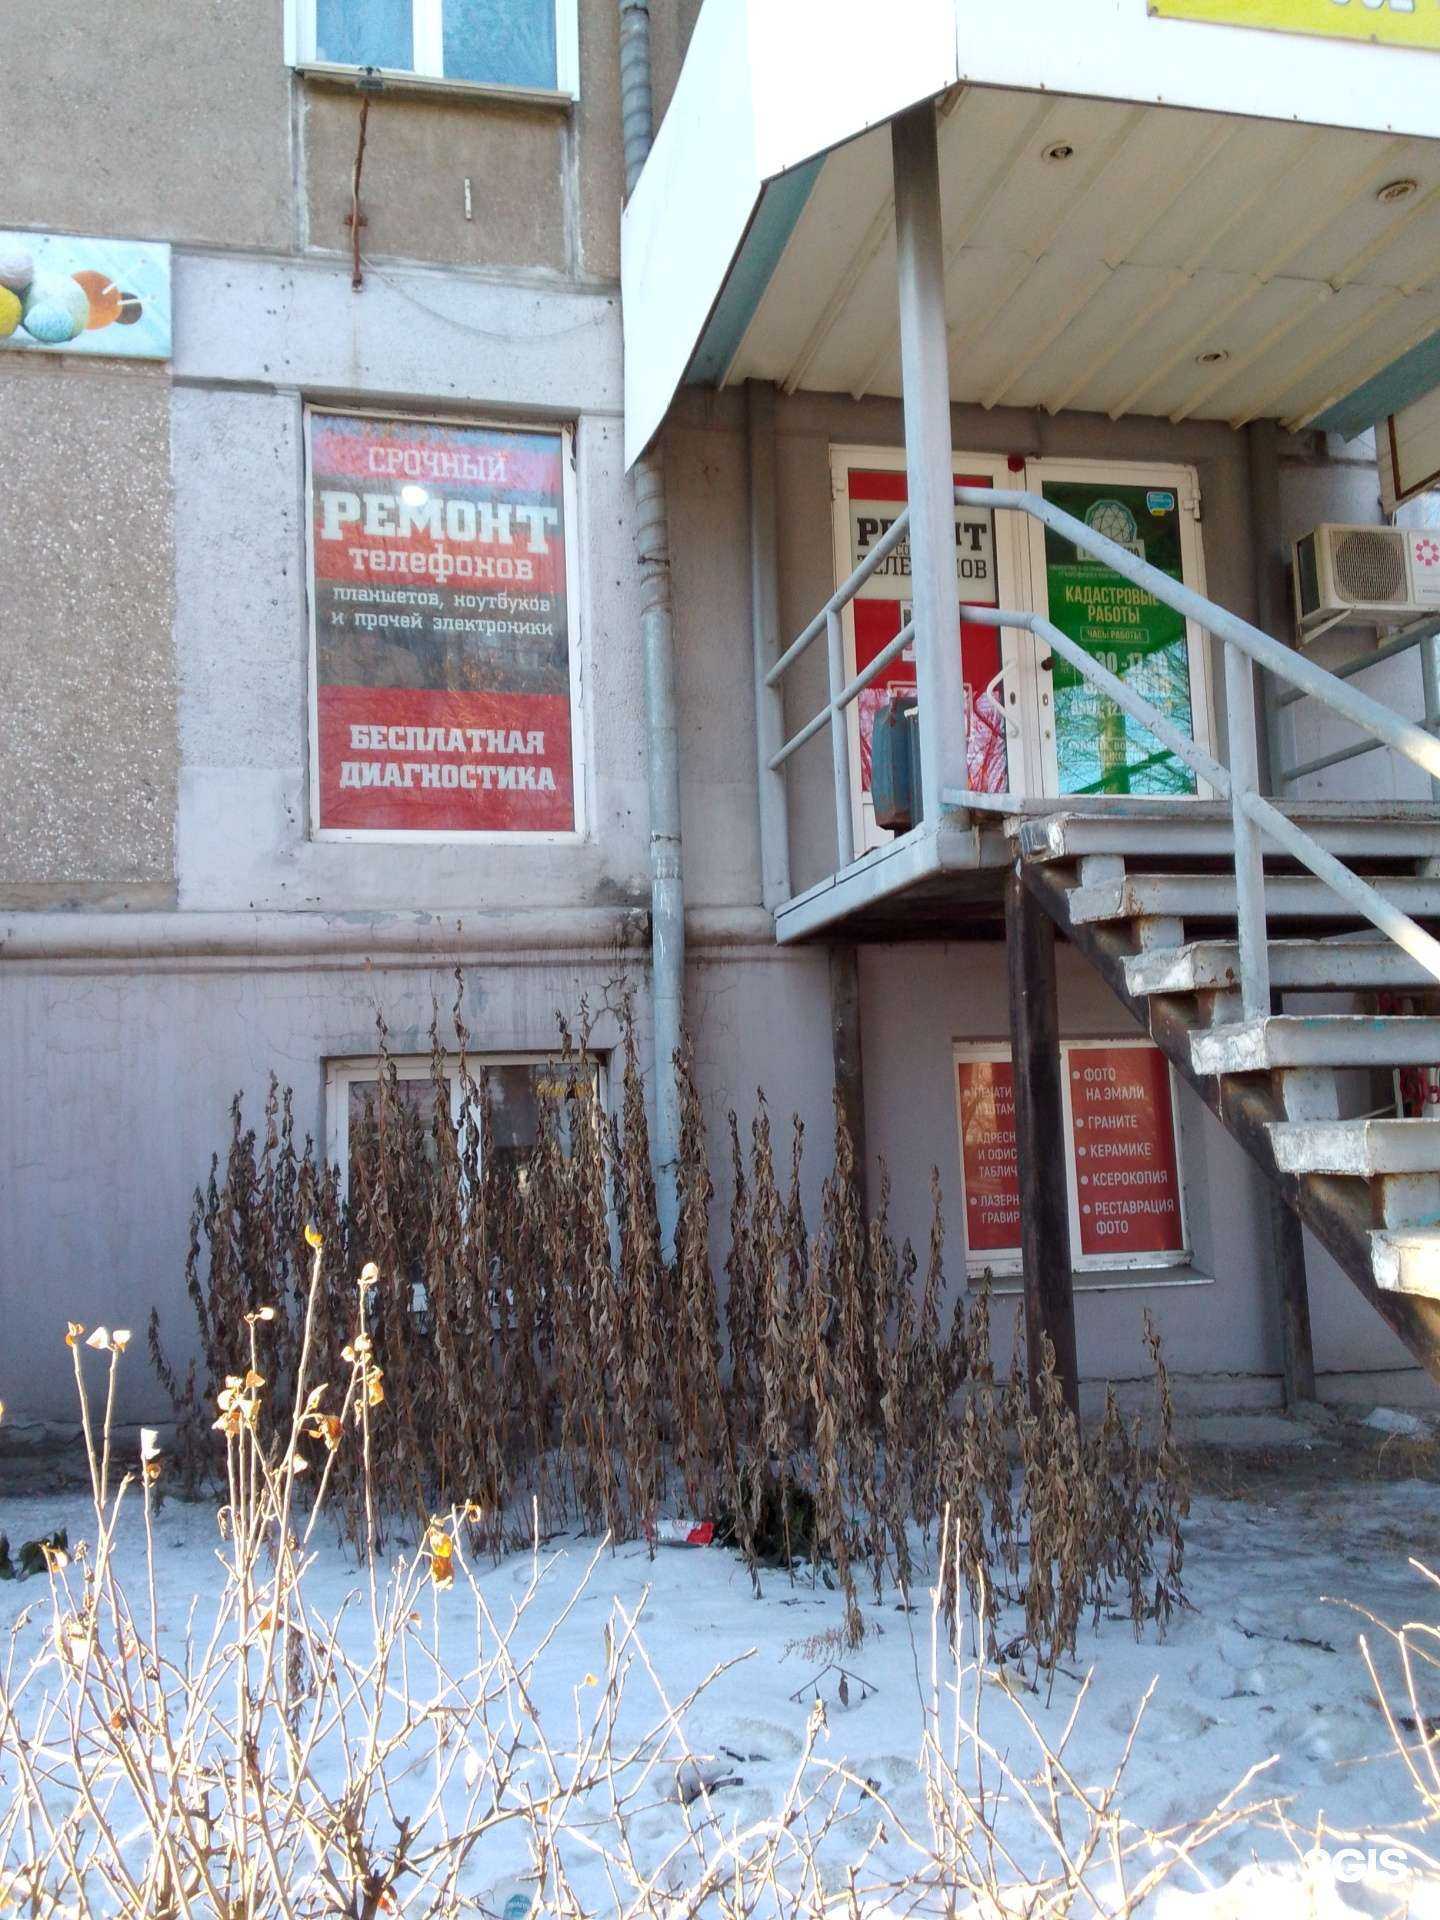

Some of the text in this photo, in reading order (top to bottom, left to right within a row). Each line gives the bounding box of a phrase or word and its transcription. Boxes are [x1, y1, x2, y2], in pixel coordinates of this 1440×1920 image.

[368, 446, 507, 482] СРОЧНЫЙ
[320, 490, 558, 554] РЕМОНТ
[349, 543, 534, 583] телефонов
[333, 586, 551, 614] планшетов, ноутбуков
[1088, 605, 1140, 624] РАБОТЫ
[332, 611, 553, 636] и прочей электроники
[350, 725, 545, 755] БЕСПЛАТНАЯ
[340, 761, 556, 791] ДИАГНОСТИКА
[1084, 1068, 1116, 1082] ФОТО
[1086, 1086, 1144, 1100] НА ЭМАЛИ
[986, 1102, 1015, 1115] ШТАМ
[1088, 1115, 1138, 1129] ГРАНИТЕ
[977, 1131, 1016, 1144] АДРЕСН
[988, 1148, 1017, 1161] ОФИС
[1090, 1142, 1152, 1157] КЕРАМИКЕ
[979, 1165, 1018, 1177] ТАБЛИЧ
[1092, 1170, 1168, 1186] КСЕРОКОПИЯ
[980, 1194, 1020, 1206] ЛАЗЕРН
[1095, 1199, 1174, 1216] РЕСТАВРАЦИЯ
[982, 1212, 1020, 1224] ГРАВИР
[1096, 1220, 1128, 1235] ФОТО
